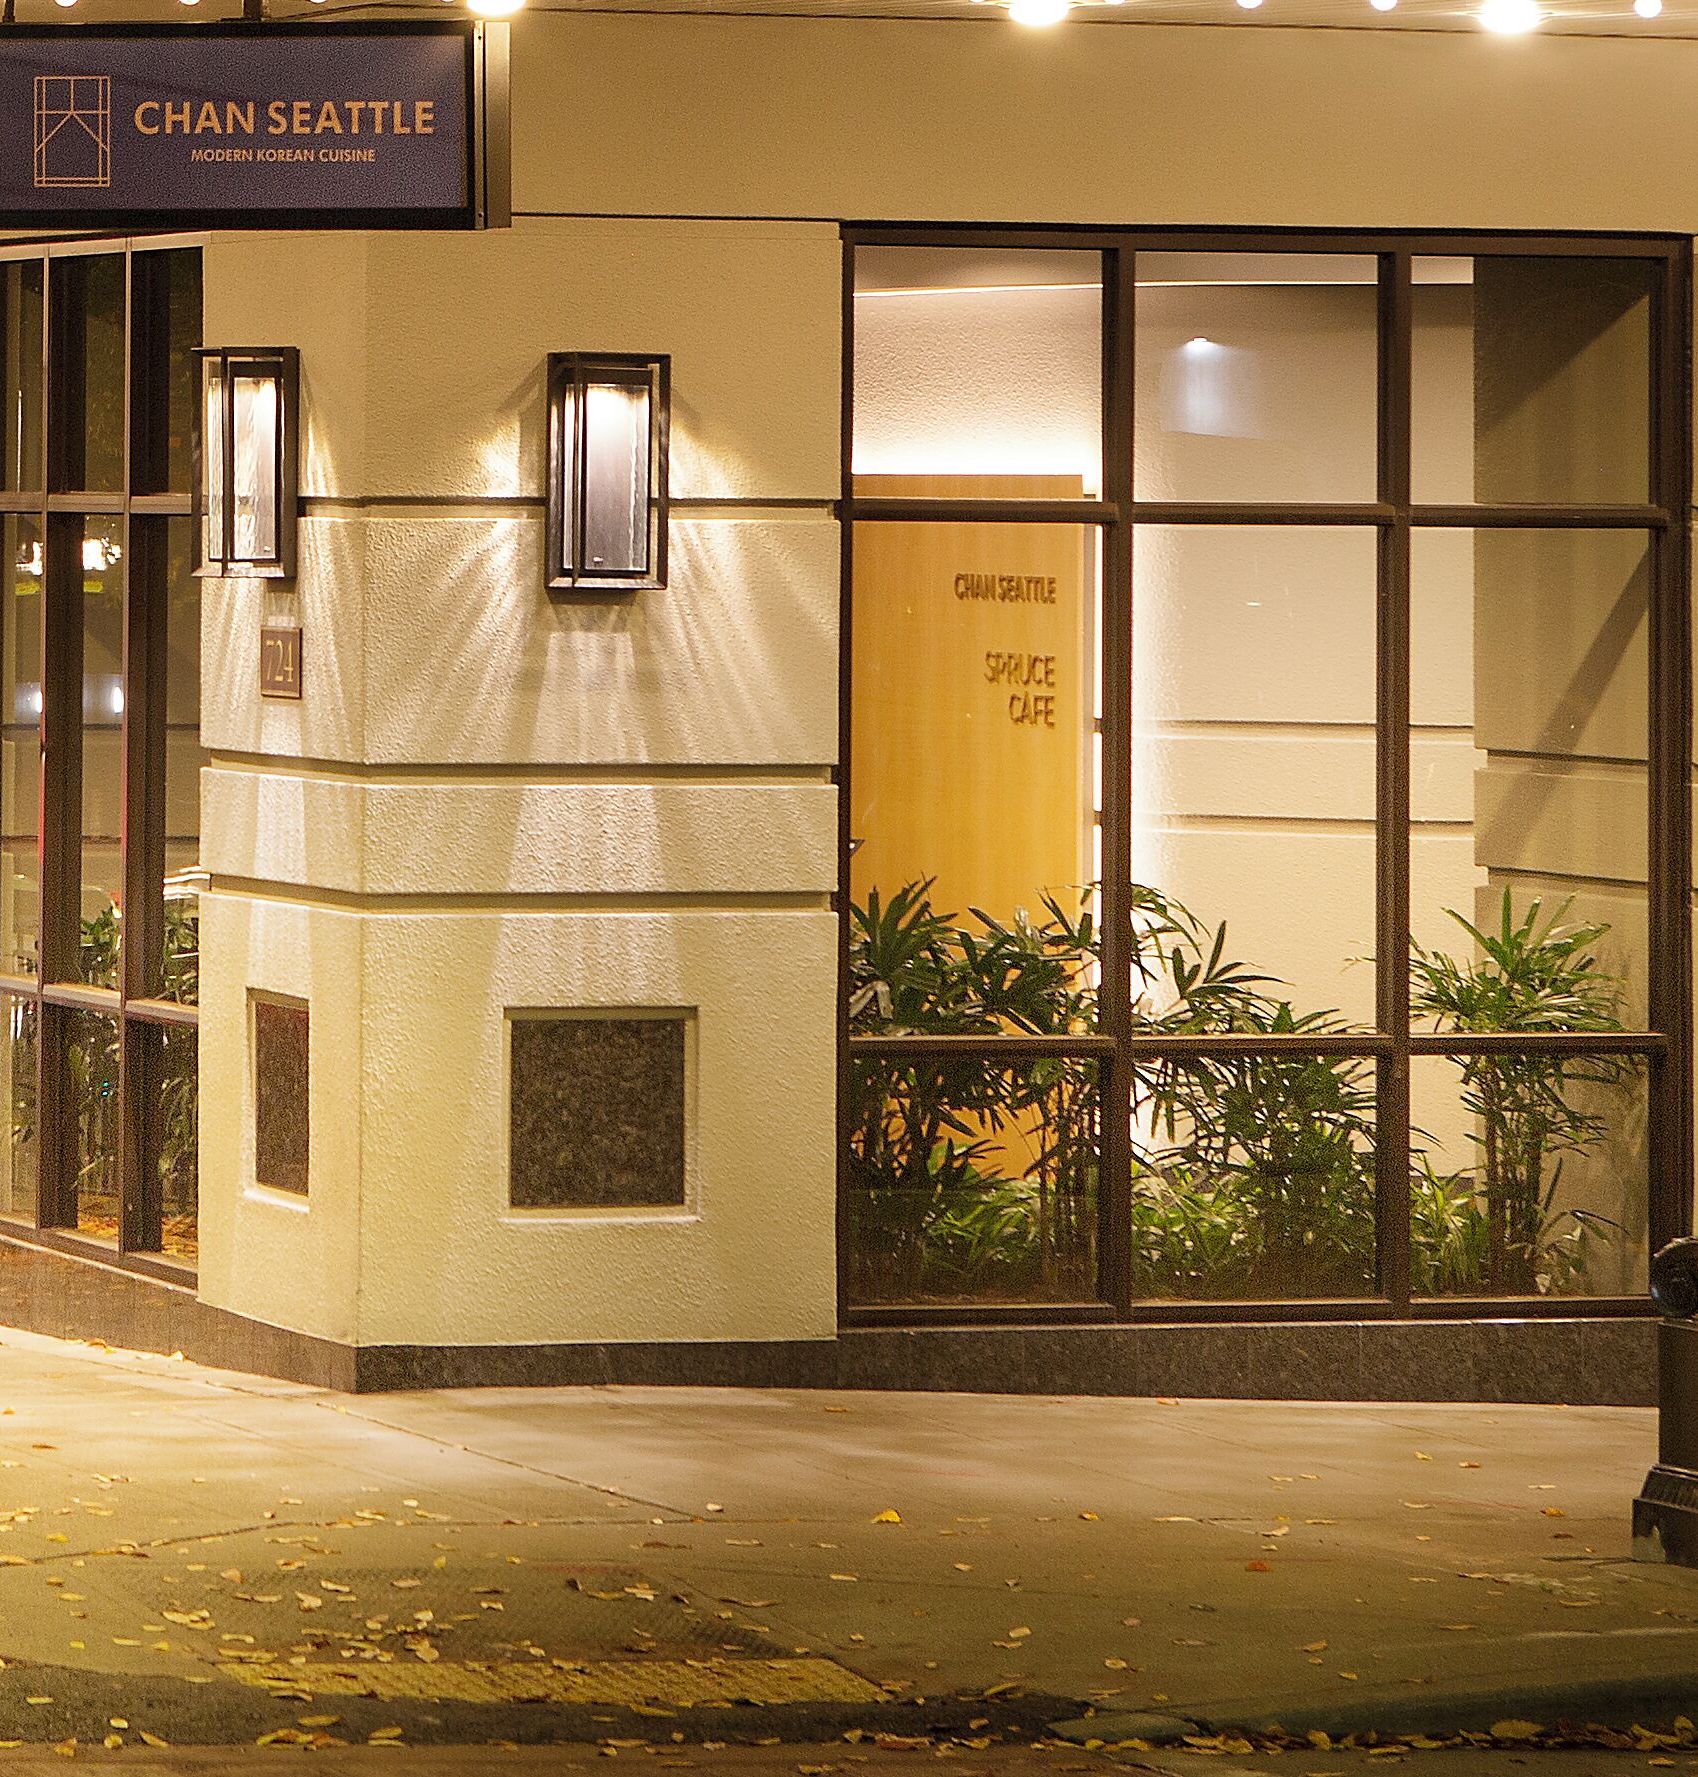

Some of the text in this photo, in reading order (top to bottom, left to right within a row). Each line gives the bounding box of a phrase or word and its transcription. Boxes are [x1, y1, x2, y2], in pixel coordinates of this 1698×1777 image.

[134, 100, 435, 135] CHAN SEATTLE
[190, 148, 376, 163] MODERN KOREAN CUISINE
[953, 572, 1056, 604] CHAN SEATTLE
[266, 639, 294, 683] 724
[984, 650, 1055, 688] SPRUCE
[1008, 691, 1055, 729] CAFE
